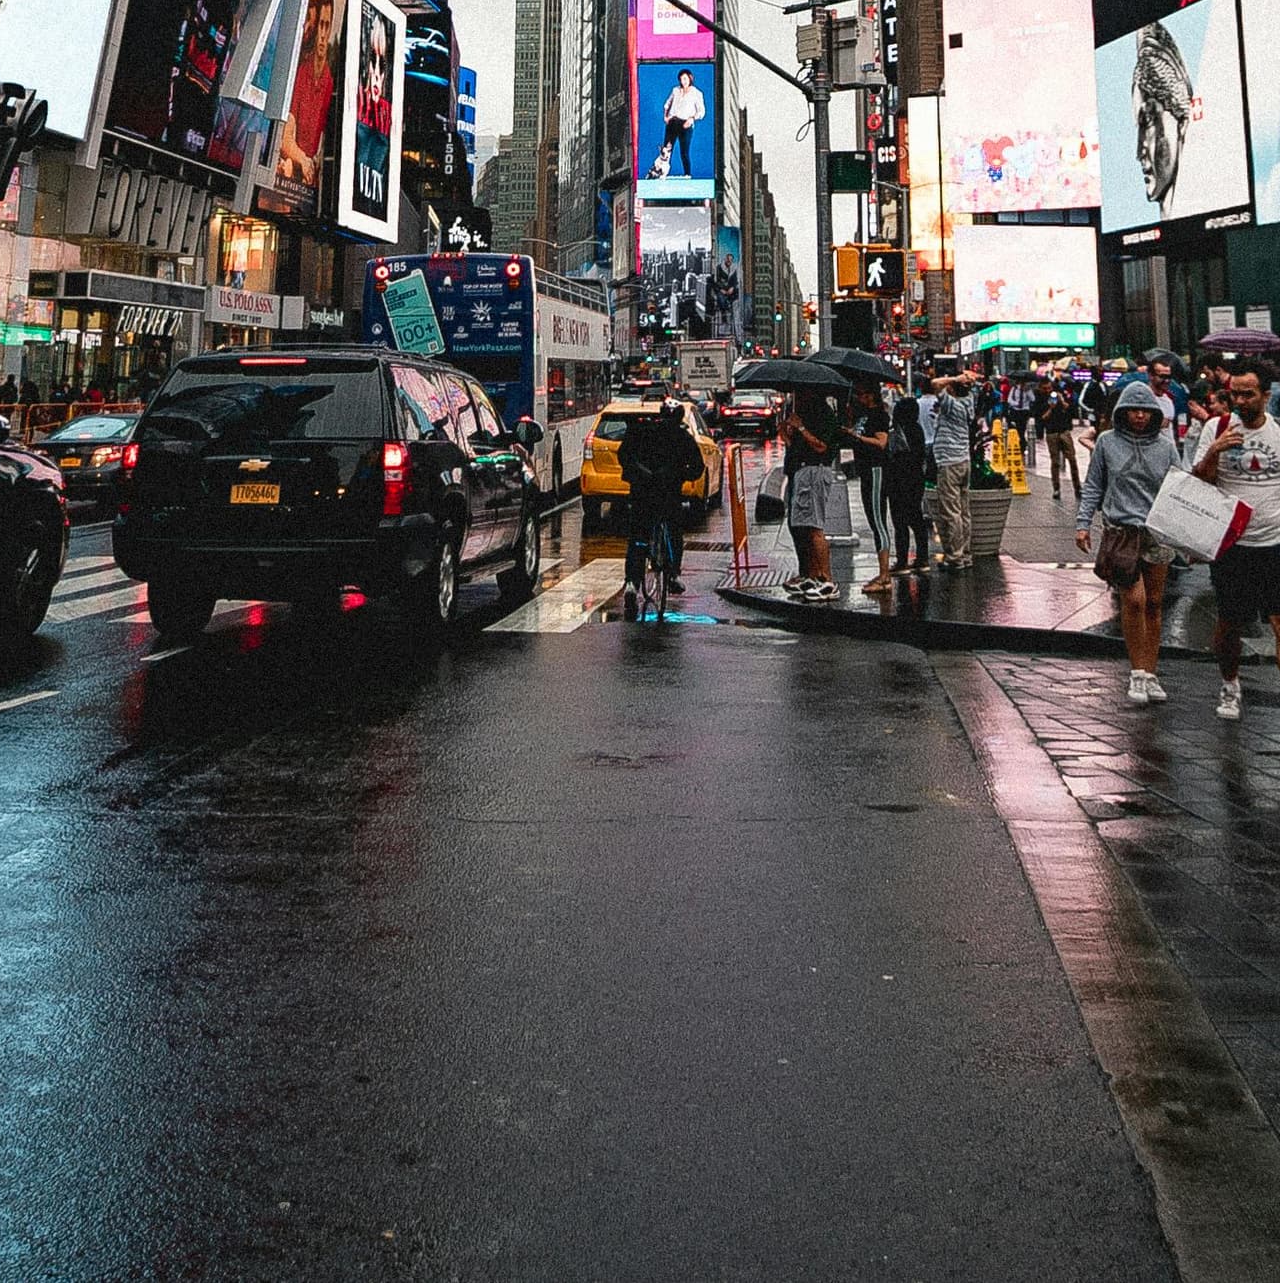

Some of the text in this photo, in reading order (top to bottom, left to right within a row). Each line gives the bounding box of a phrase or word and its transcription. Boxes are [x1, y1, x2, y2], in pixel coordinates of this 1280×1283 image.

[444, 133, 453, 175] 1500
[388, 262, 407, 274] 185
[220, 291, 234, 308] U.S.
[234, 294, 254, 311] POLO
[116, 305, 168, 336] FOREVER
[398, 322, 435, 345] 100+
[453, 342, 522, 352] NewYorkPass.com
